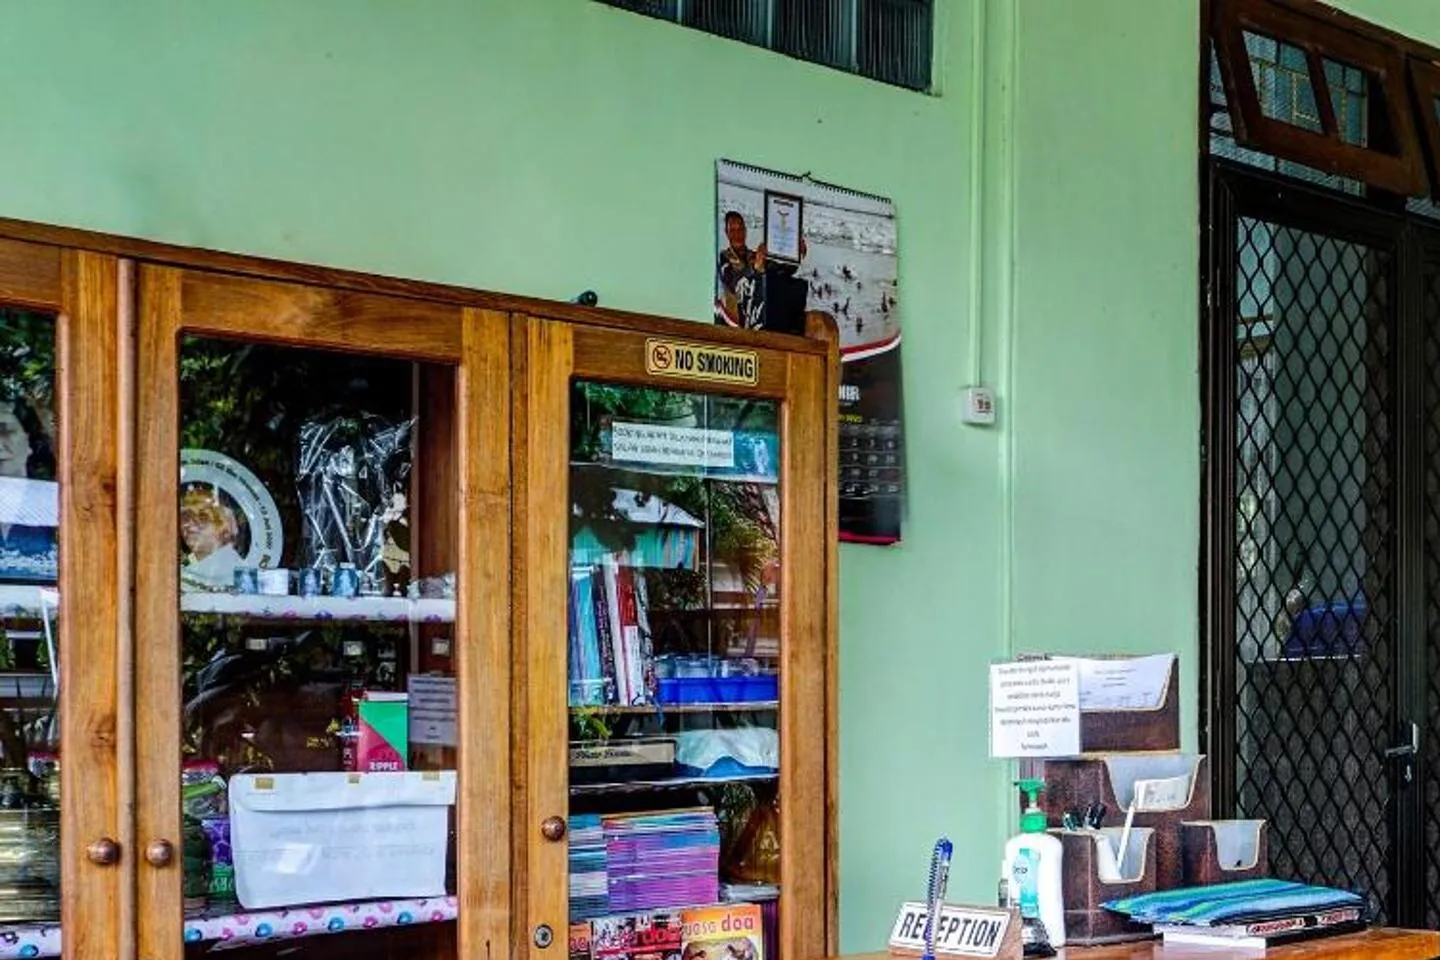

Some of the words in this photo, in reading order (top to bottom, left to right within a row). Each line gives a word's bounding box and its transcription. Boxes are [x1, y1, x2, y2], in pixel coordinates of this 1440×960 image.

[675, 349, 694, 371] NO
[697, 352, 754, 378] SMOKING
[899, 911, 1002, 948] REEPTION
